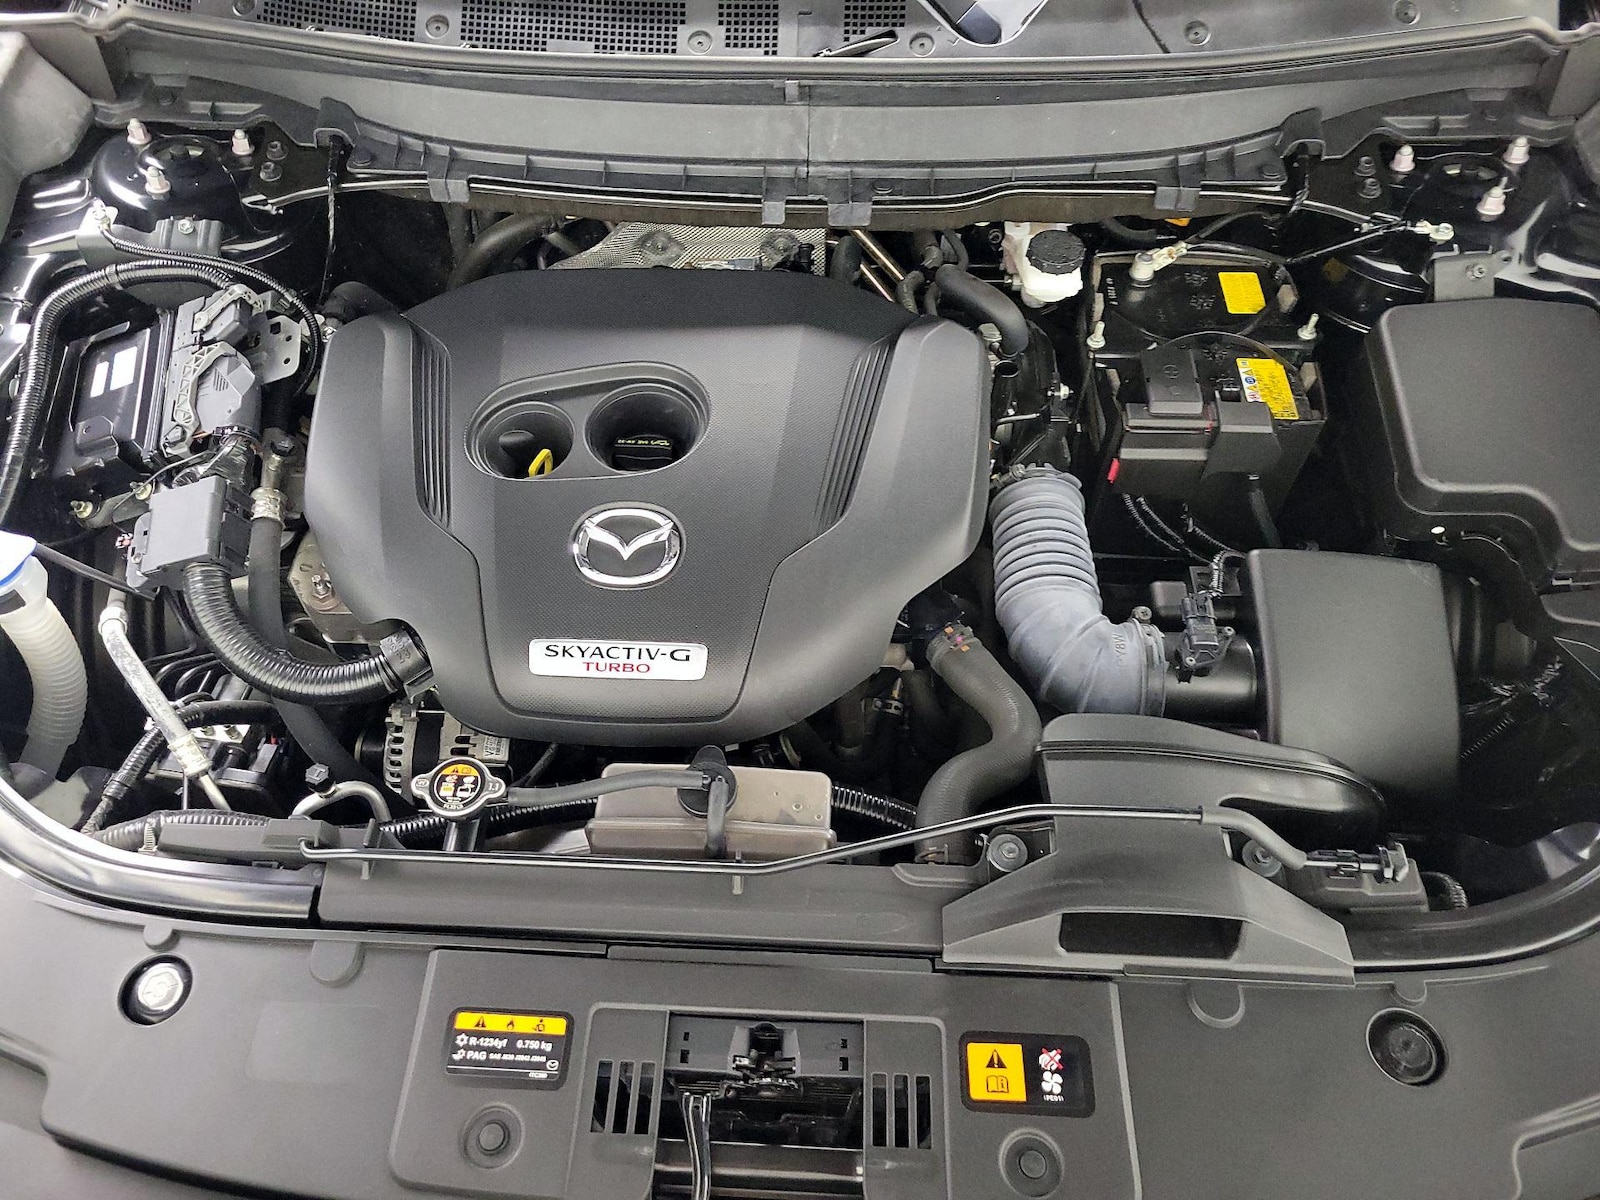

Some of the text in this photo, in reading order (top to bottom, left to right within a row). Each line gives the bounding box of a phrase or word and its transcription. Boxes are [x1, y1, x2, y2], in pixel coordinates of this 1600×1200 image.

[544, 644, 691, 662] SKYACTIV-G
[582, 661, 651, 674] TURBO
[468, 1036, 553, 1052] R-1234yf 0.750 kg
[466, 1051, 487, 1060] PAG
